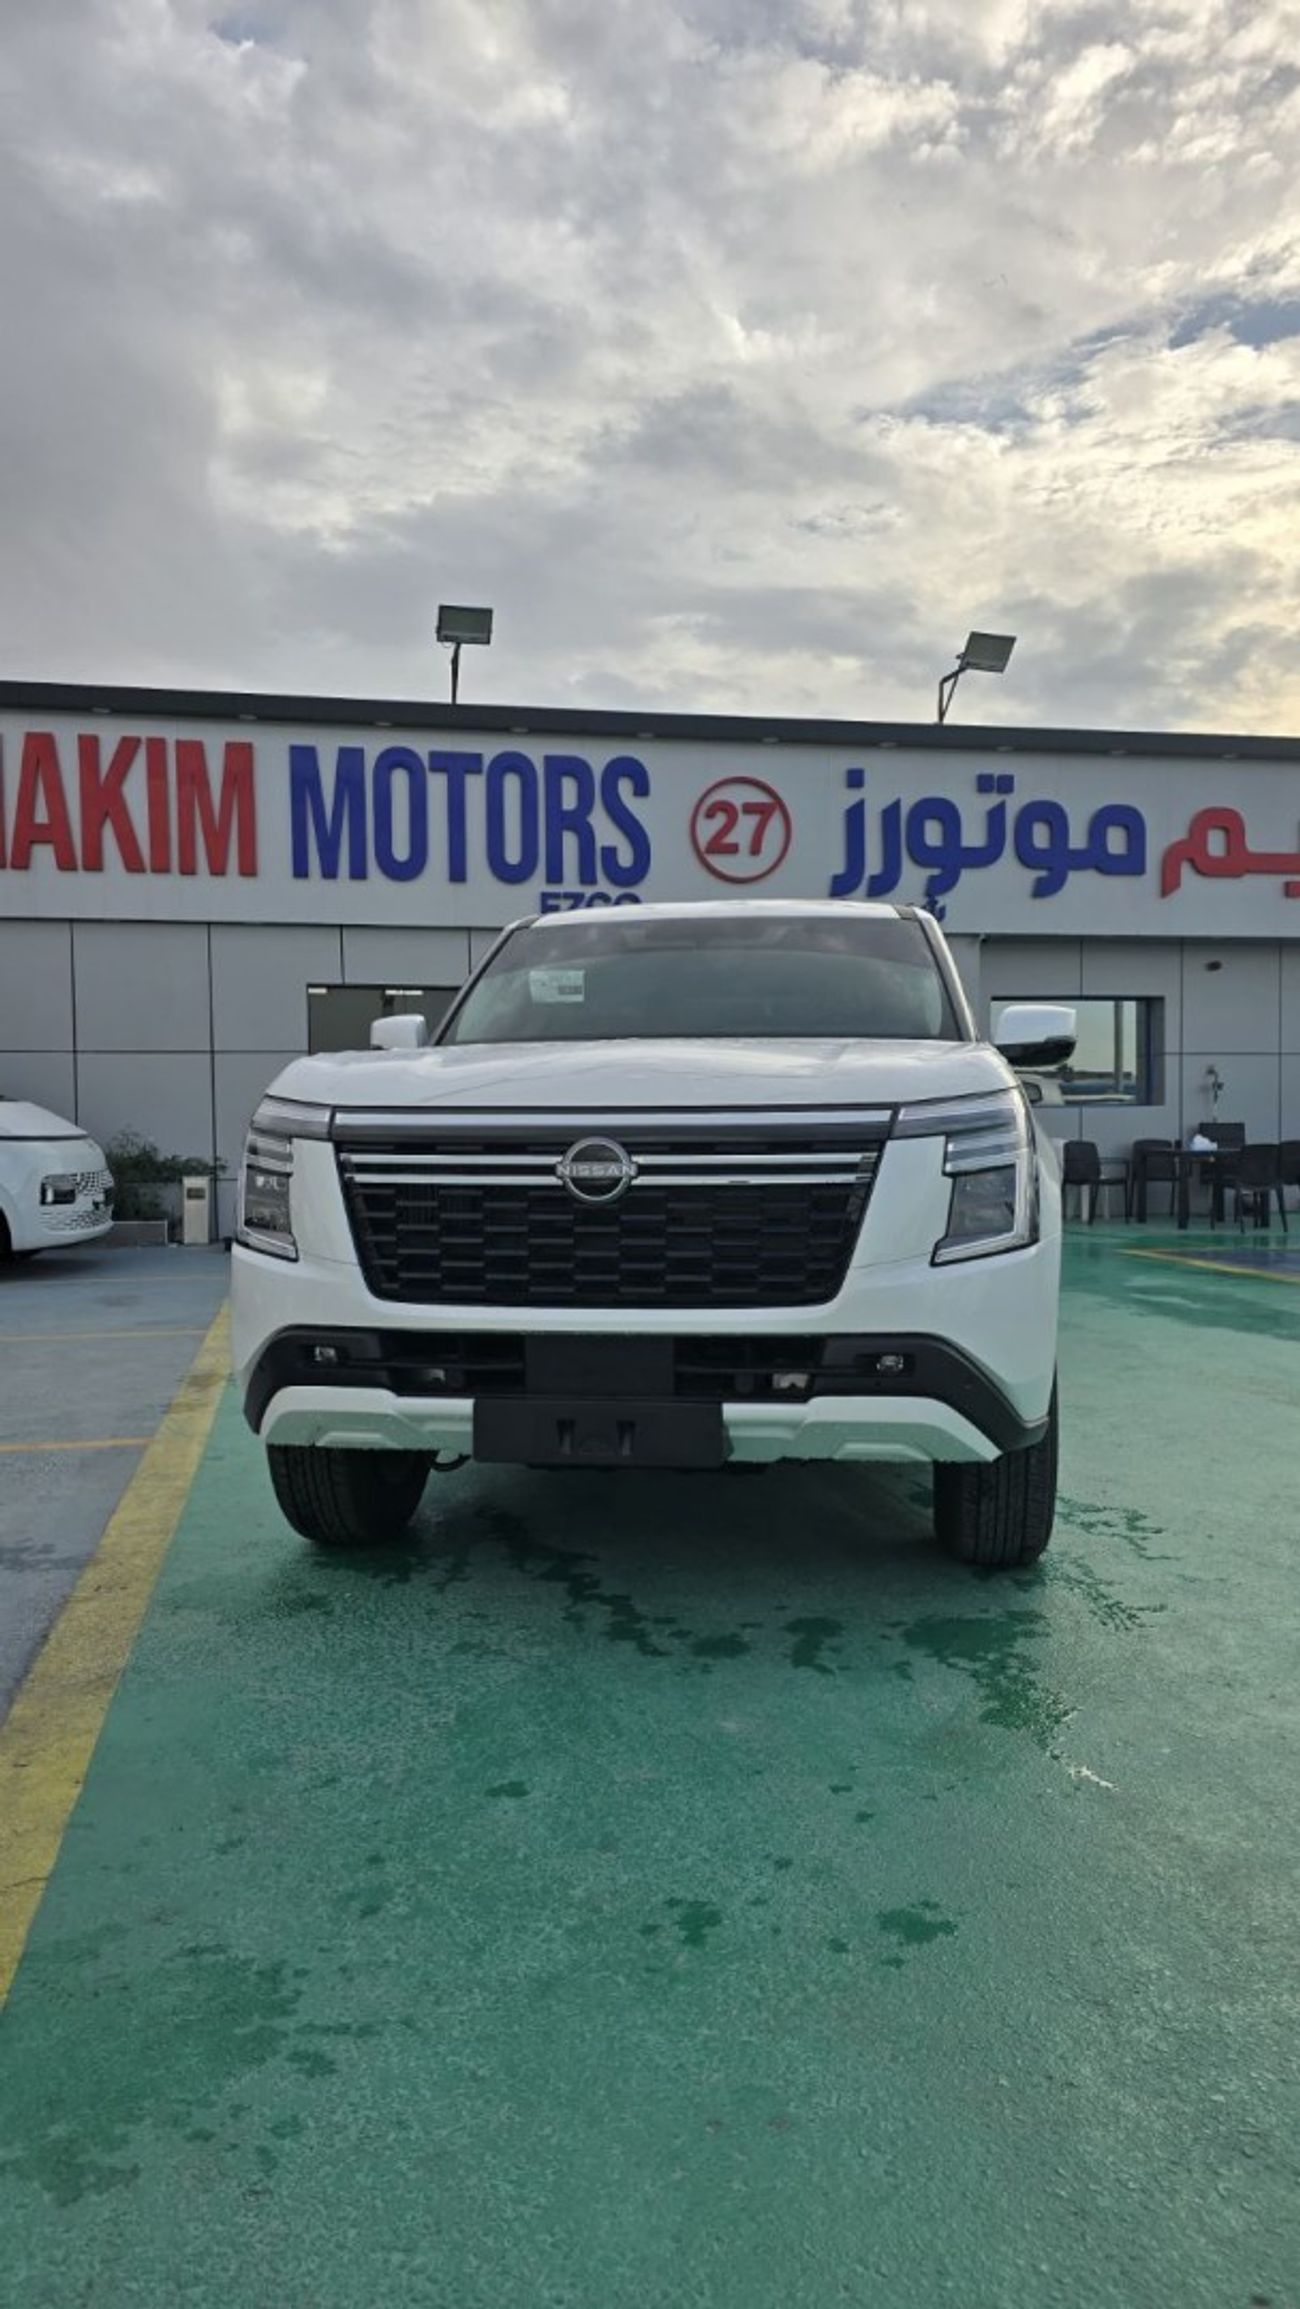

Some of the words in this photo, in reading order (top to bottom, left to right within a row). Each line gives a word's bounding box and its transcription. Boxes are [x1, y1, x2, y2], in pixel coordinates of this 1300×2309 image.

[0, 731, 258, 878] AKIM
[288, 744, 653, 888] MOTORS
[702, 800, 779, 857] 27
[829, 767, 1147, 899] موتورز
[556, 1162, 638, 1177] NISSAN
